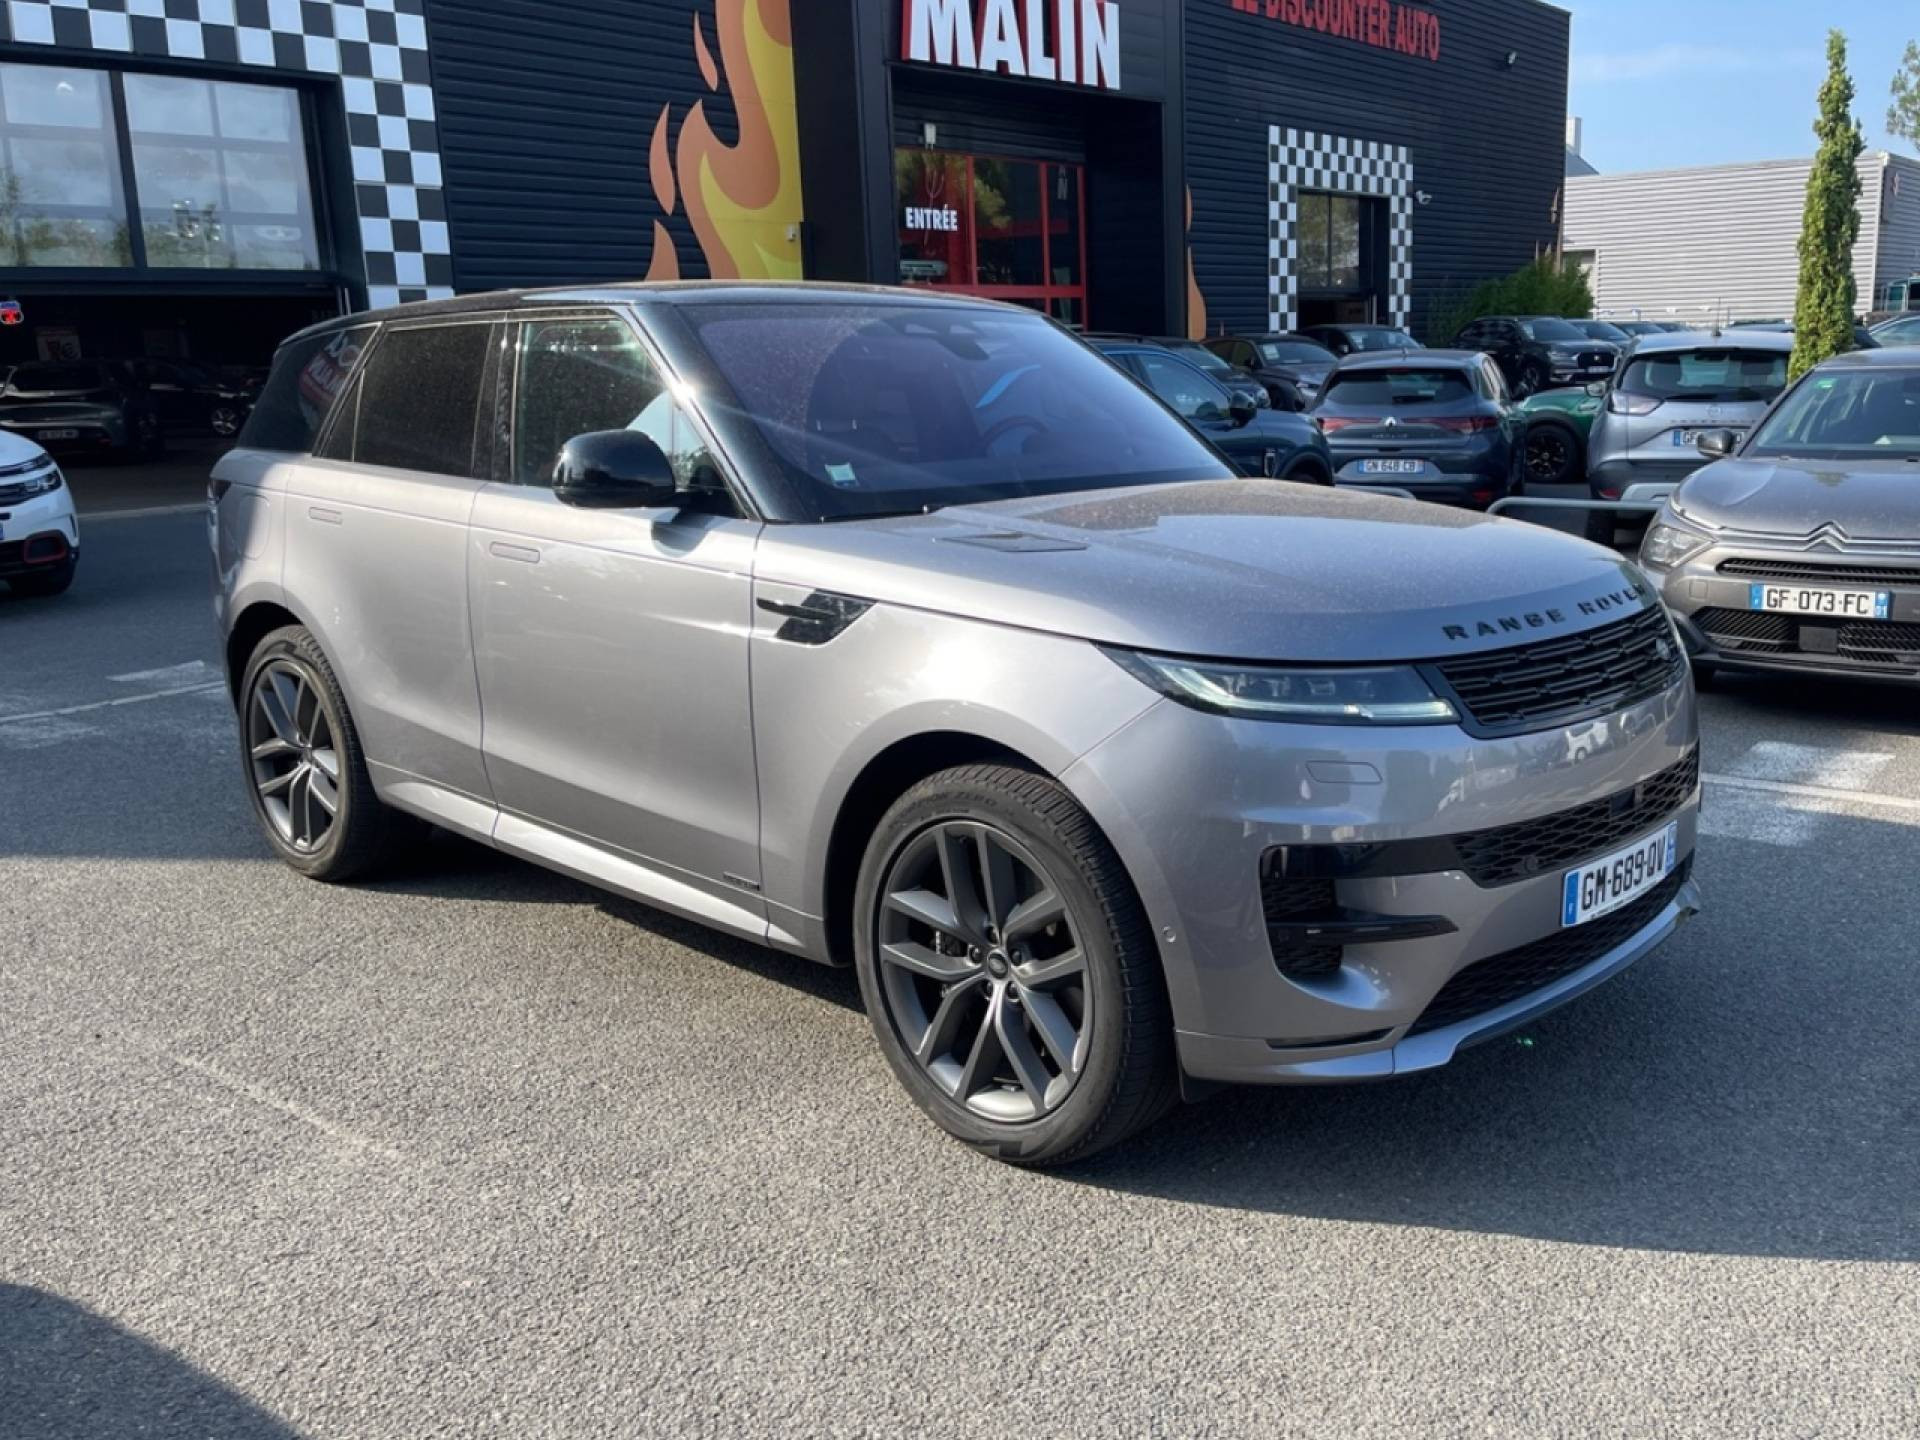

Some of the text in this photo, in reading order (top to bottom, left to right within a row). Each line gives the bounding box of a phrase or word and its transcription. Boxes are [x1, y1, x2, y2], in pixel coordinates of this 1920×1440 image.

[903, 0, 1121, 90] MALIN
[1394, 5, 1440, 62] AUTO
[905, 203, 958, 231] ENTRÉE
[1441, 608, 1566, 640] RANGE
